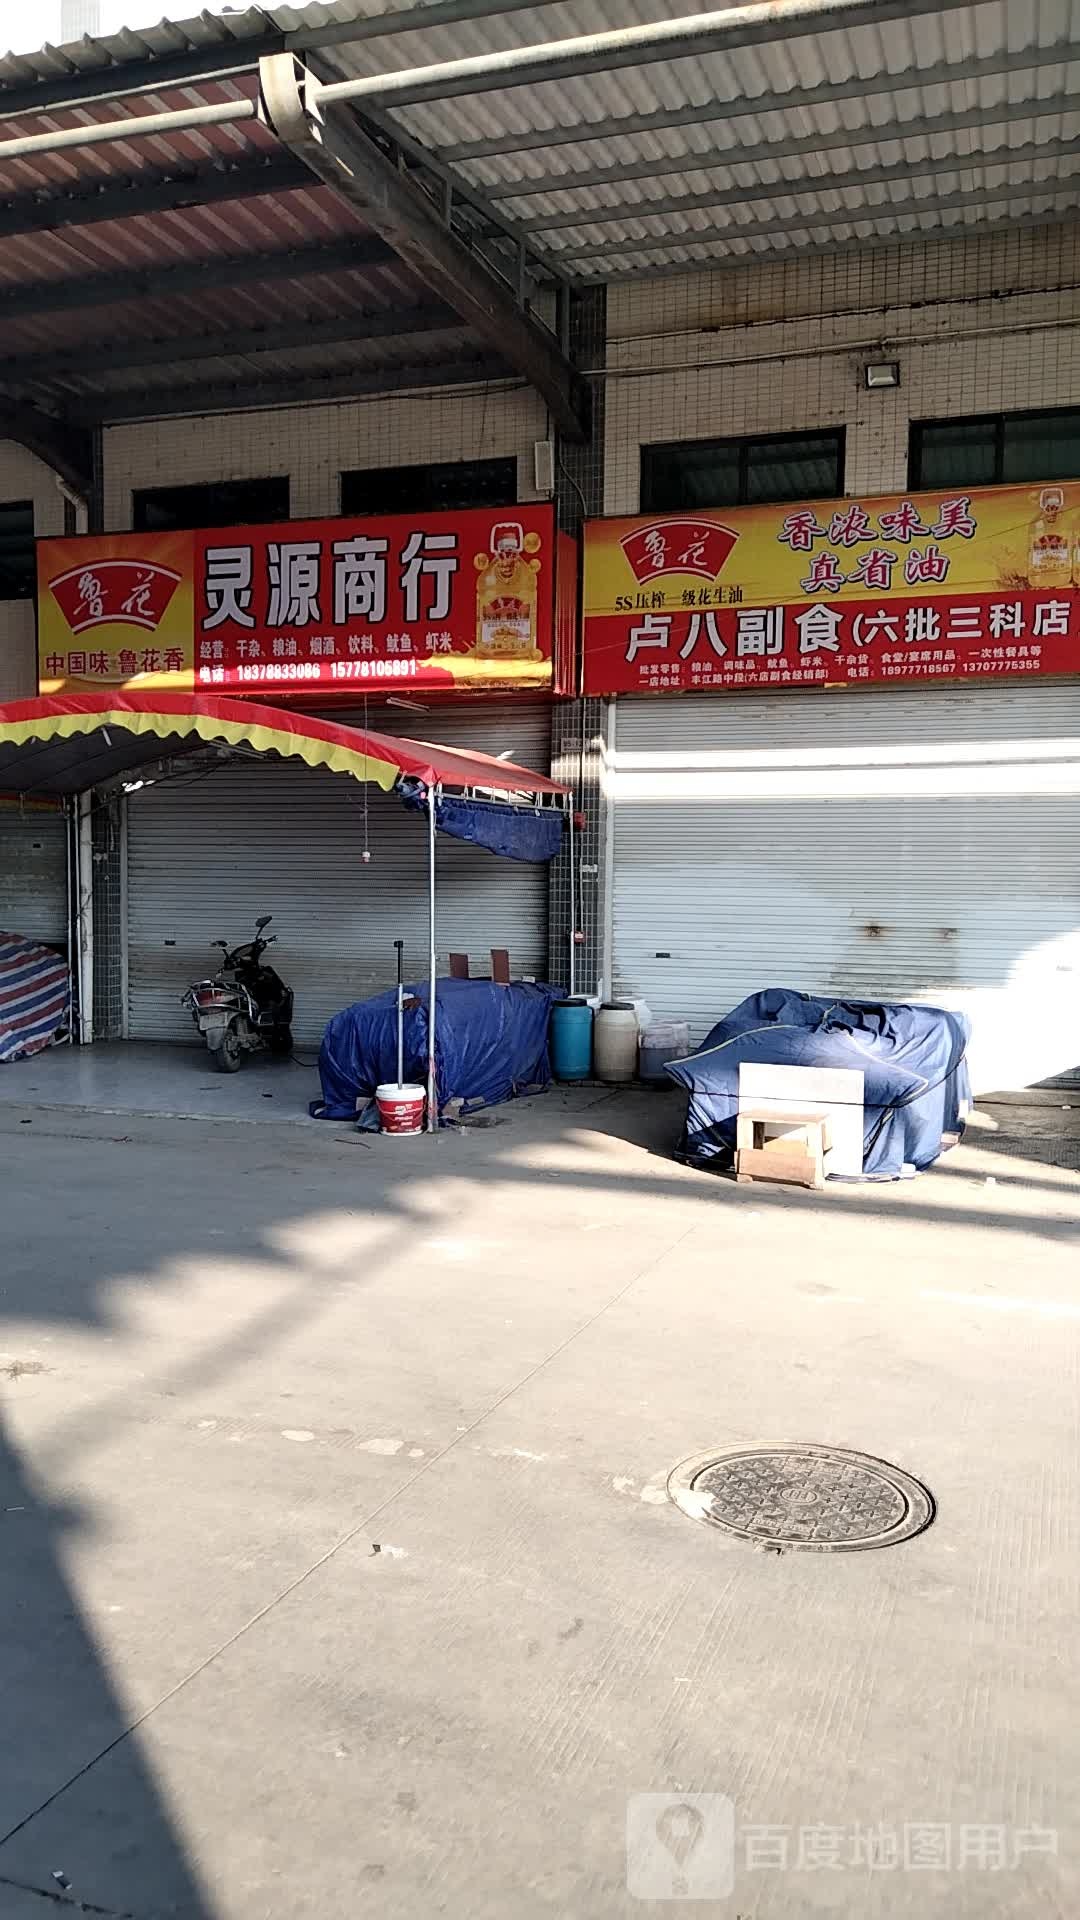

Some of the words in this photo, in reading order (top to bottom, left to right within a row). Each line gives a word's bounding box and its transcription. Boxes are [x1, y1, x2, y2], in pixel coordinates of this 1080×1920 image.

[778, 497, 976, 551] 香浓味美
[636, 530, 709, 568] 鲁花
[801, 545, 949, 594] 真省油
[73, 571, 156, 617] 鲁花
[204, 533, 457, 630] 灵源商行
[46, 650, 109, 676] 中国味
[118, 647, 184, 675] 鲁花香
